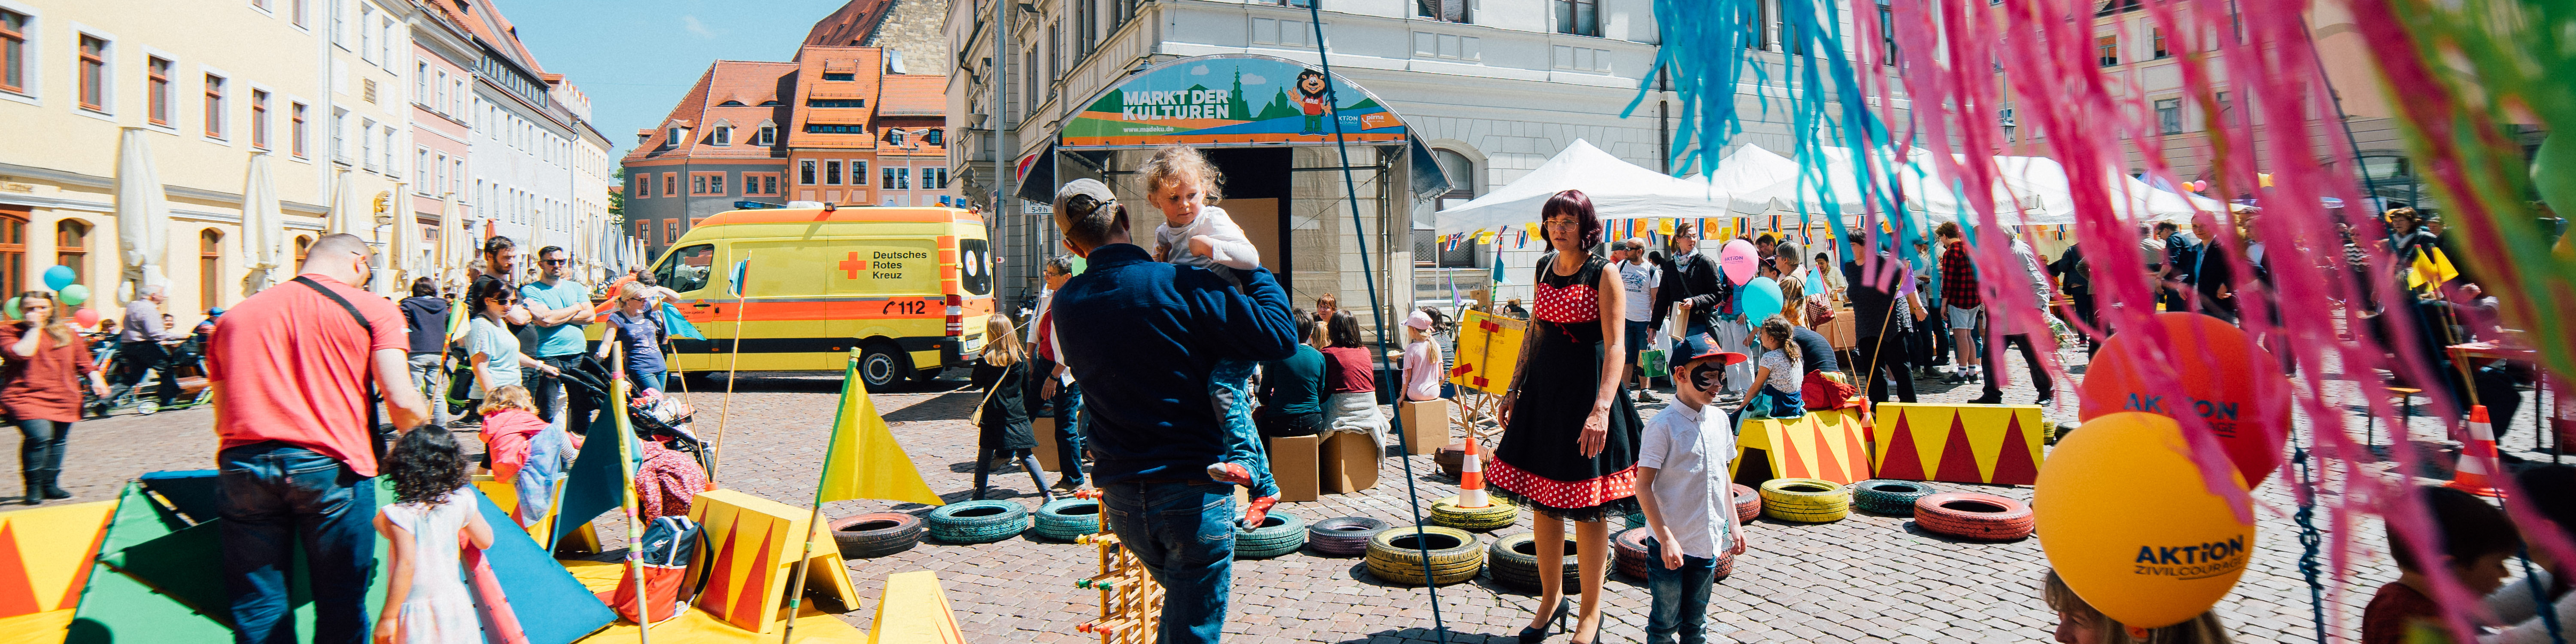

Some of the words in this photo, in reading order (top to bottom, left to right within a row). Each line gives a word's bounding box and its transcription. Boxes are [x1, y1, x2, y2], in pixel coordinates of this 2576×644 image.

[1123, 91, 1188, 105] MARKT
[1191, 89, 1229, 104] DER
[1123, 105, 1229, 120] KULTUREN
[898, 301, 925, 314] 112
[2134, 555, 2244, 577] ZIVILCOURAGE
